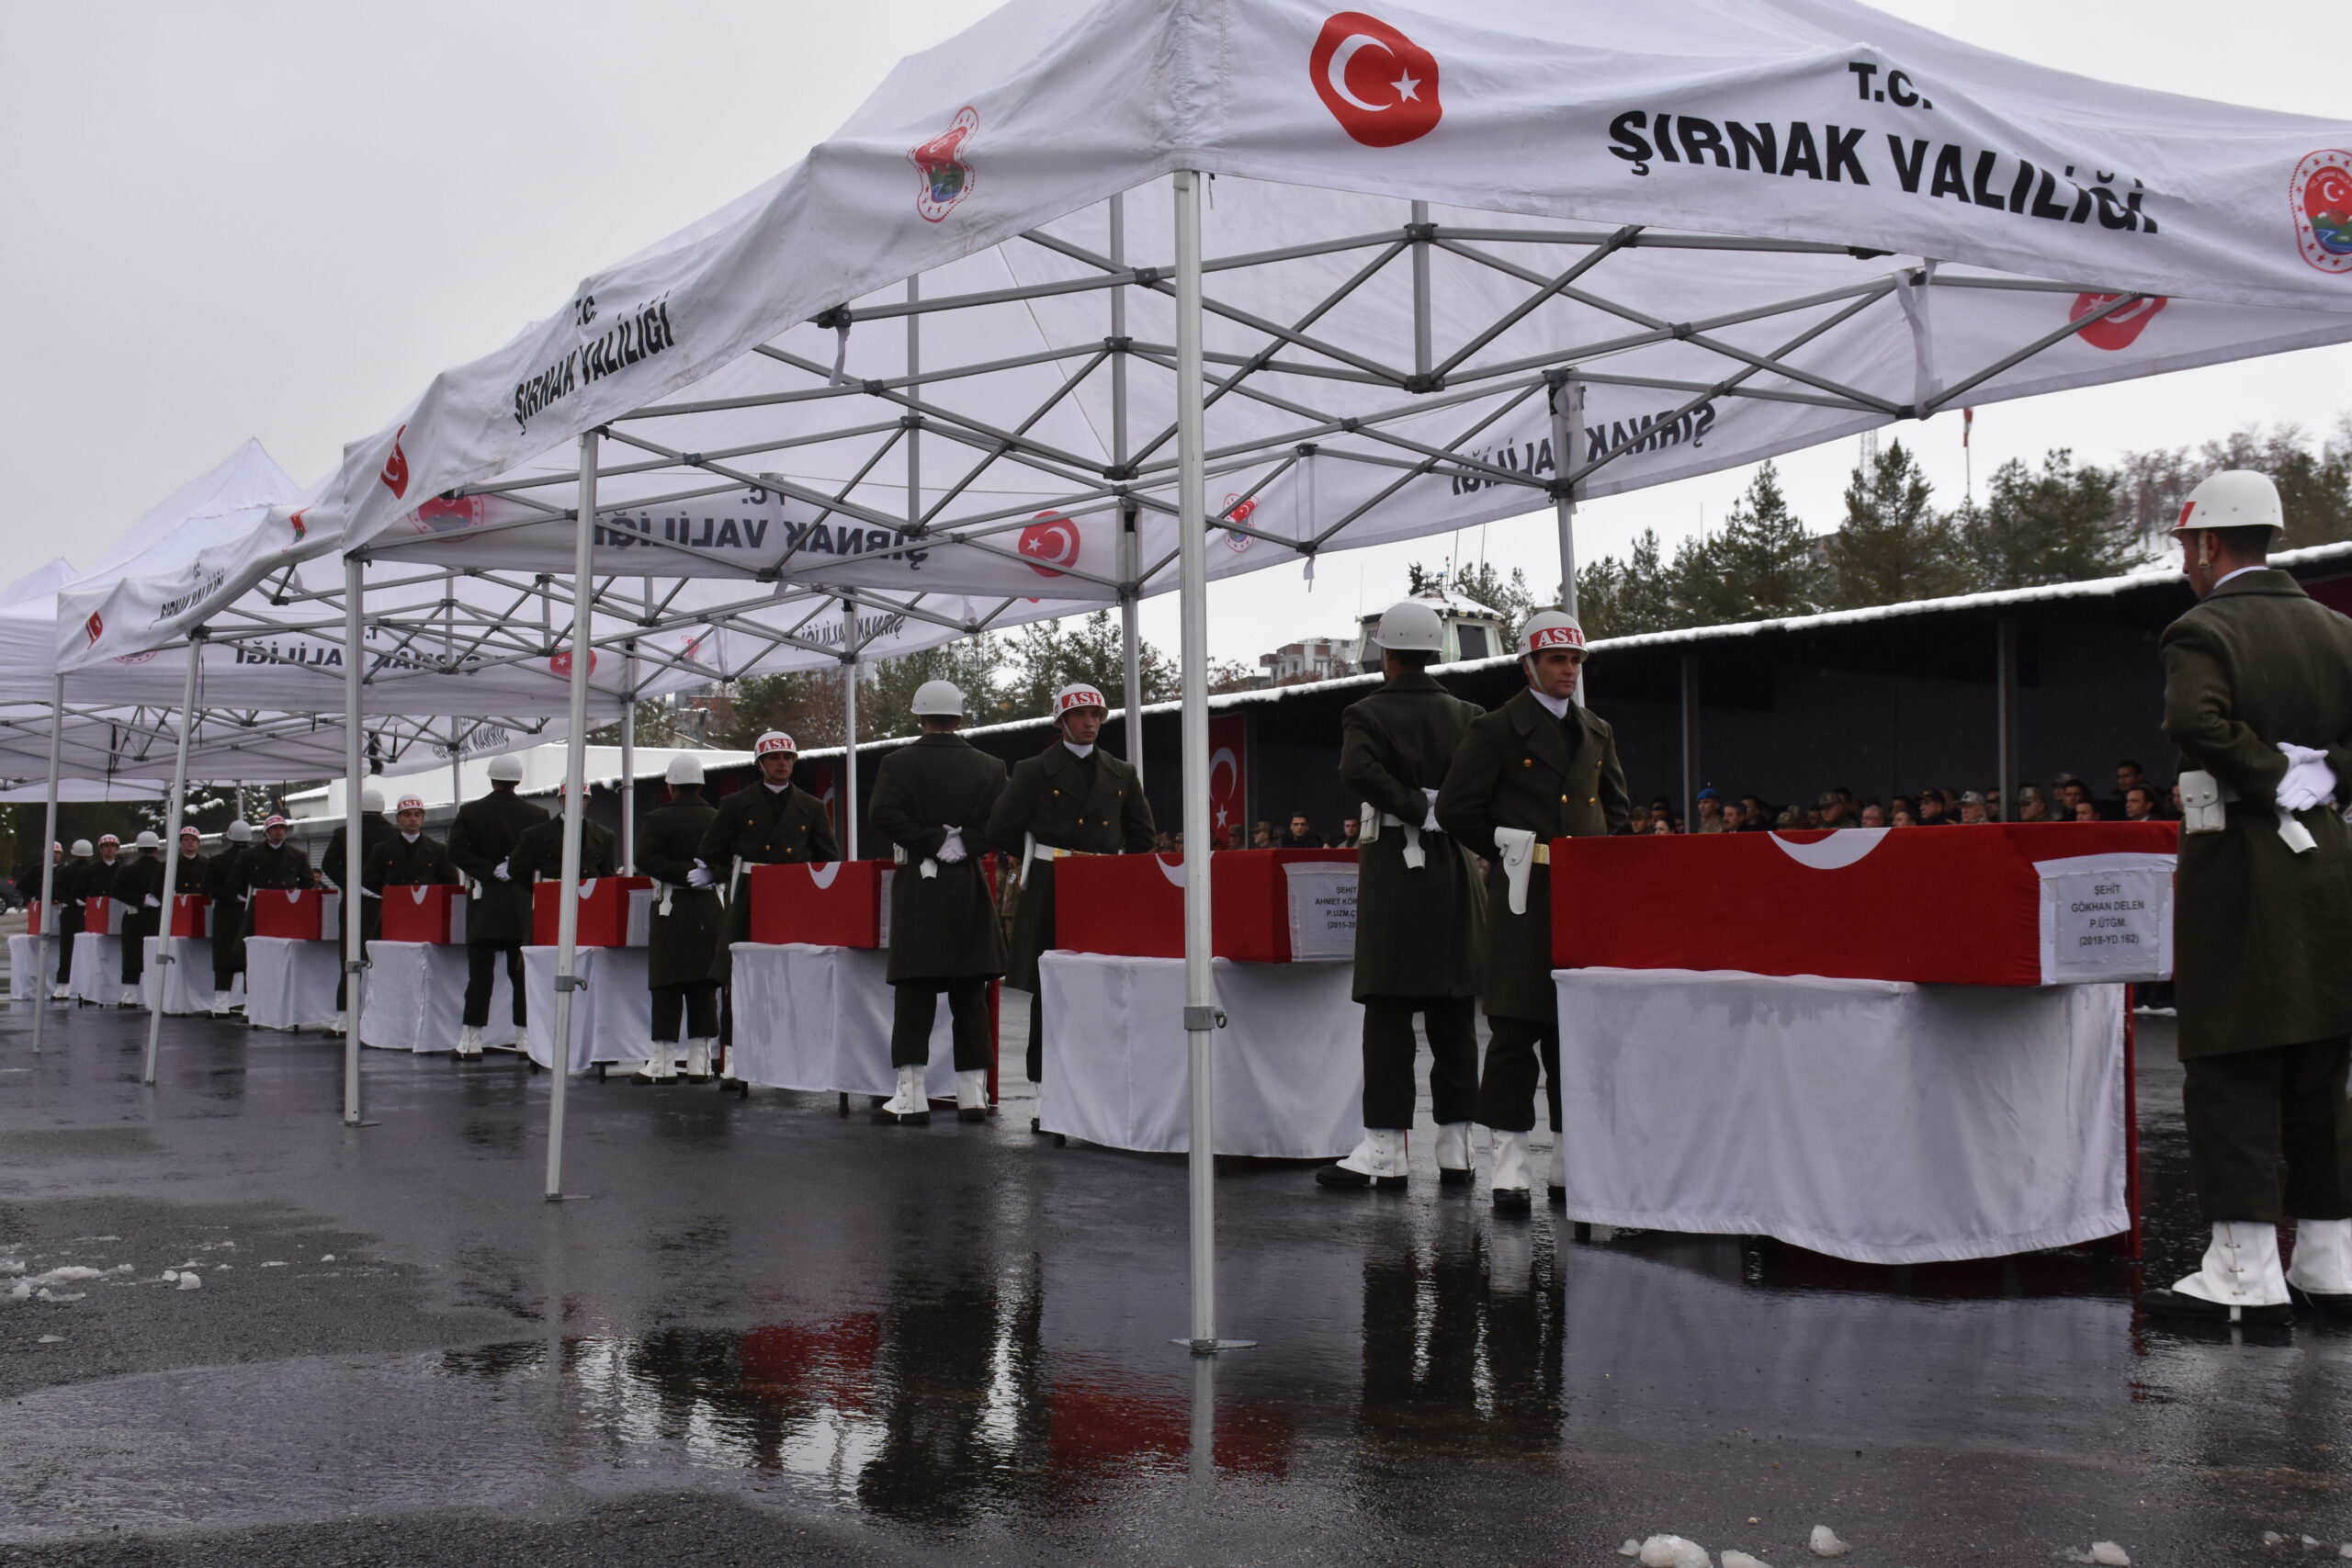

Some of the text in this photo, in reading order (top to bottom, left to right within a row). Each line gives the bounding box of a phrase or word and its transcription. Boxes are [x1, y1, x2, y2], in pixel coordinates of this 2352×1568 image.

[1849, 62, 1932, 110] T.C.
[1608, 110, 1871, 186] ŞIRNAK
[514, 350, 577, 435] ŞIRNAK
[1336, 886, 1357, 895] ŞEHİT
[2094, 884, 2121, 896] ŞEHİT
[2071, 900, 2144, 912] GÖKHAN DELEN
[2079, 933, 2140, 948] (2018-YD.162)
